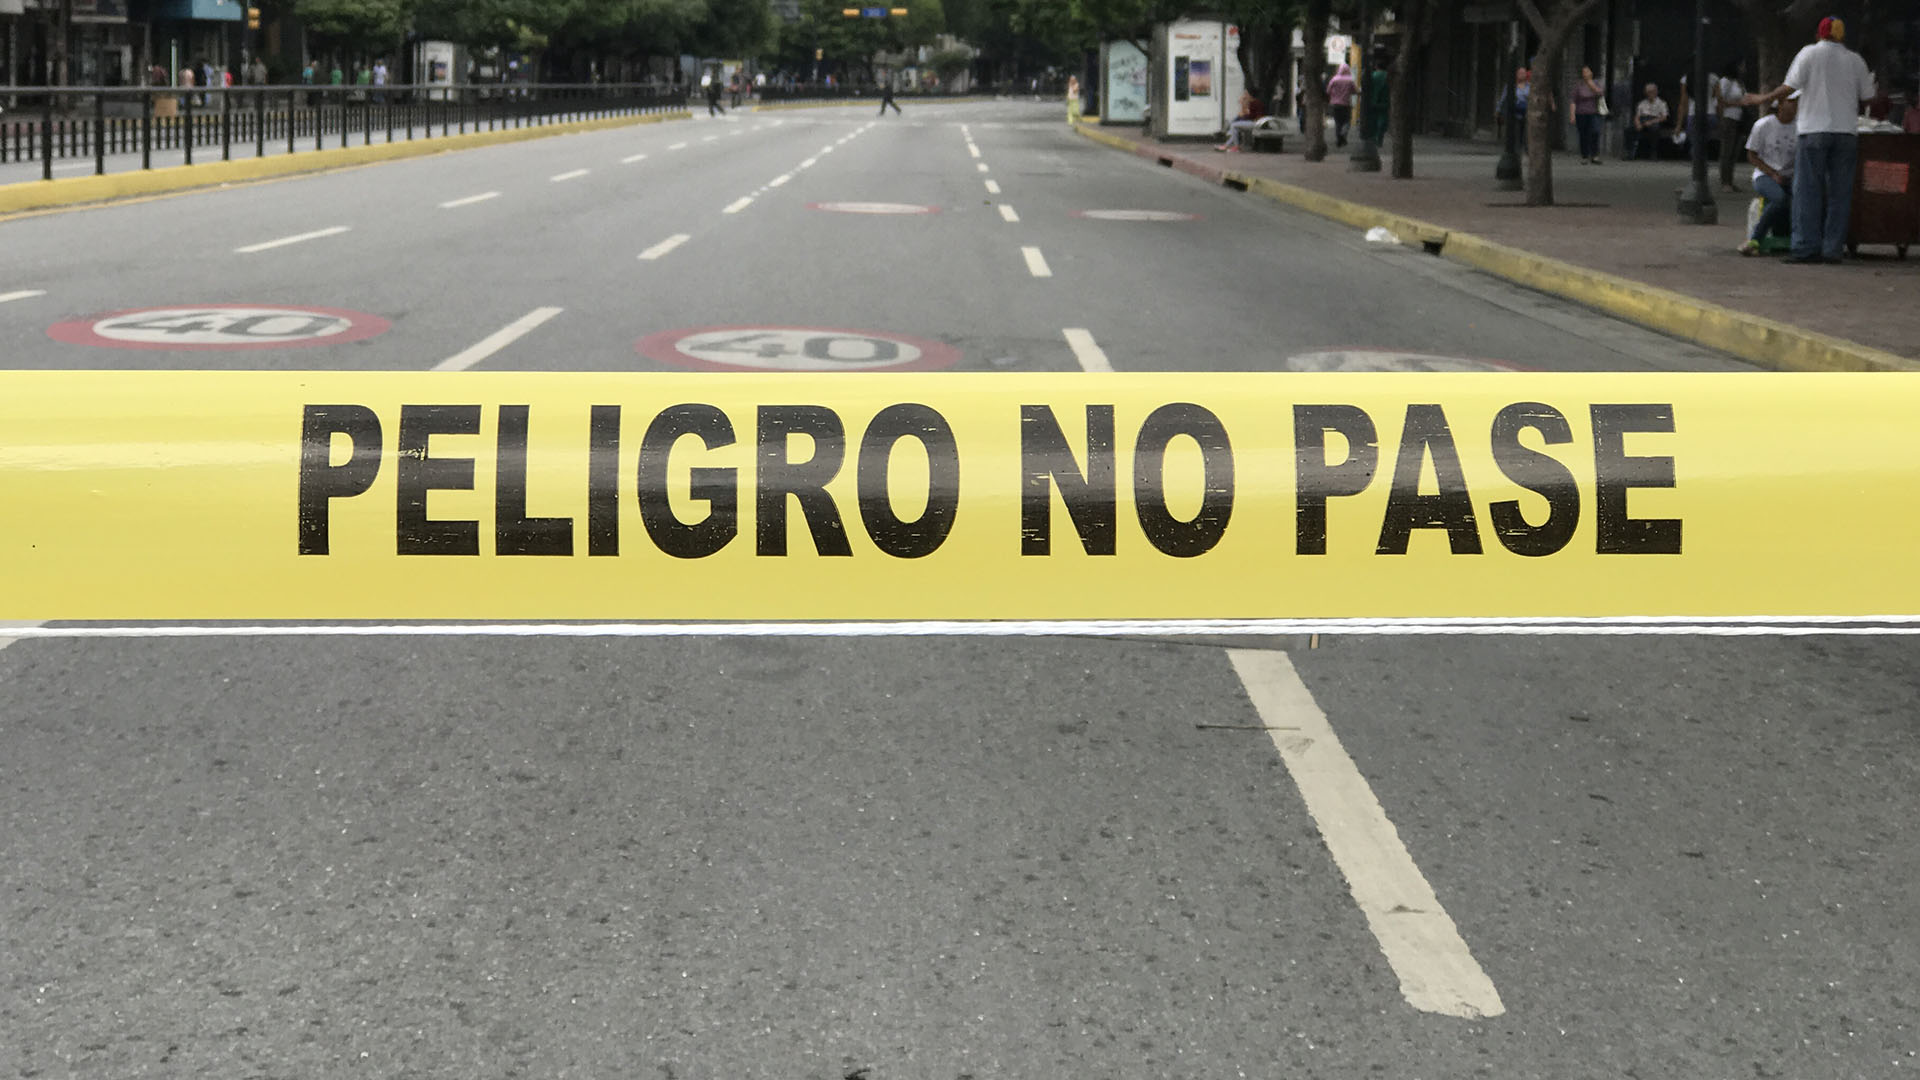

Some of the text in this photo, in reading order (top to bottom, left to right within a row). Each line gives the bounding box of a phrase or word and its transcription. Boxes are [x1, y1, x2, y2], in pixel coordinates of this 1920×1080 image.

[103, 311, 342, 338] 40
[689, 332, 899, 363] 40
[298, 402, 1683, 559] PELIGRO NO PASE
